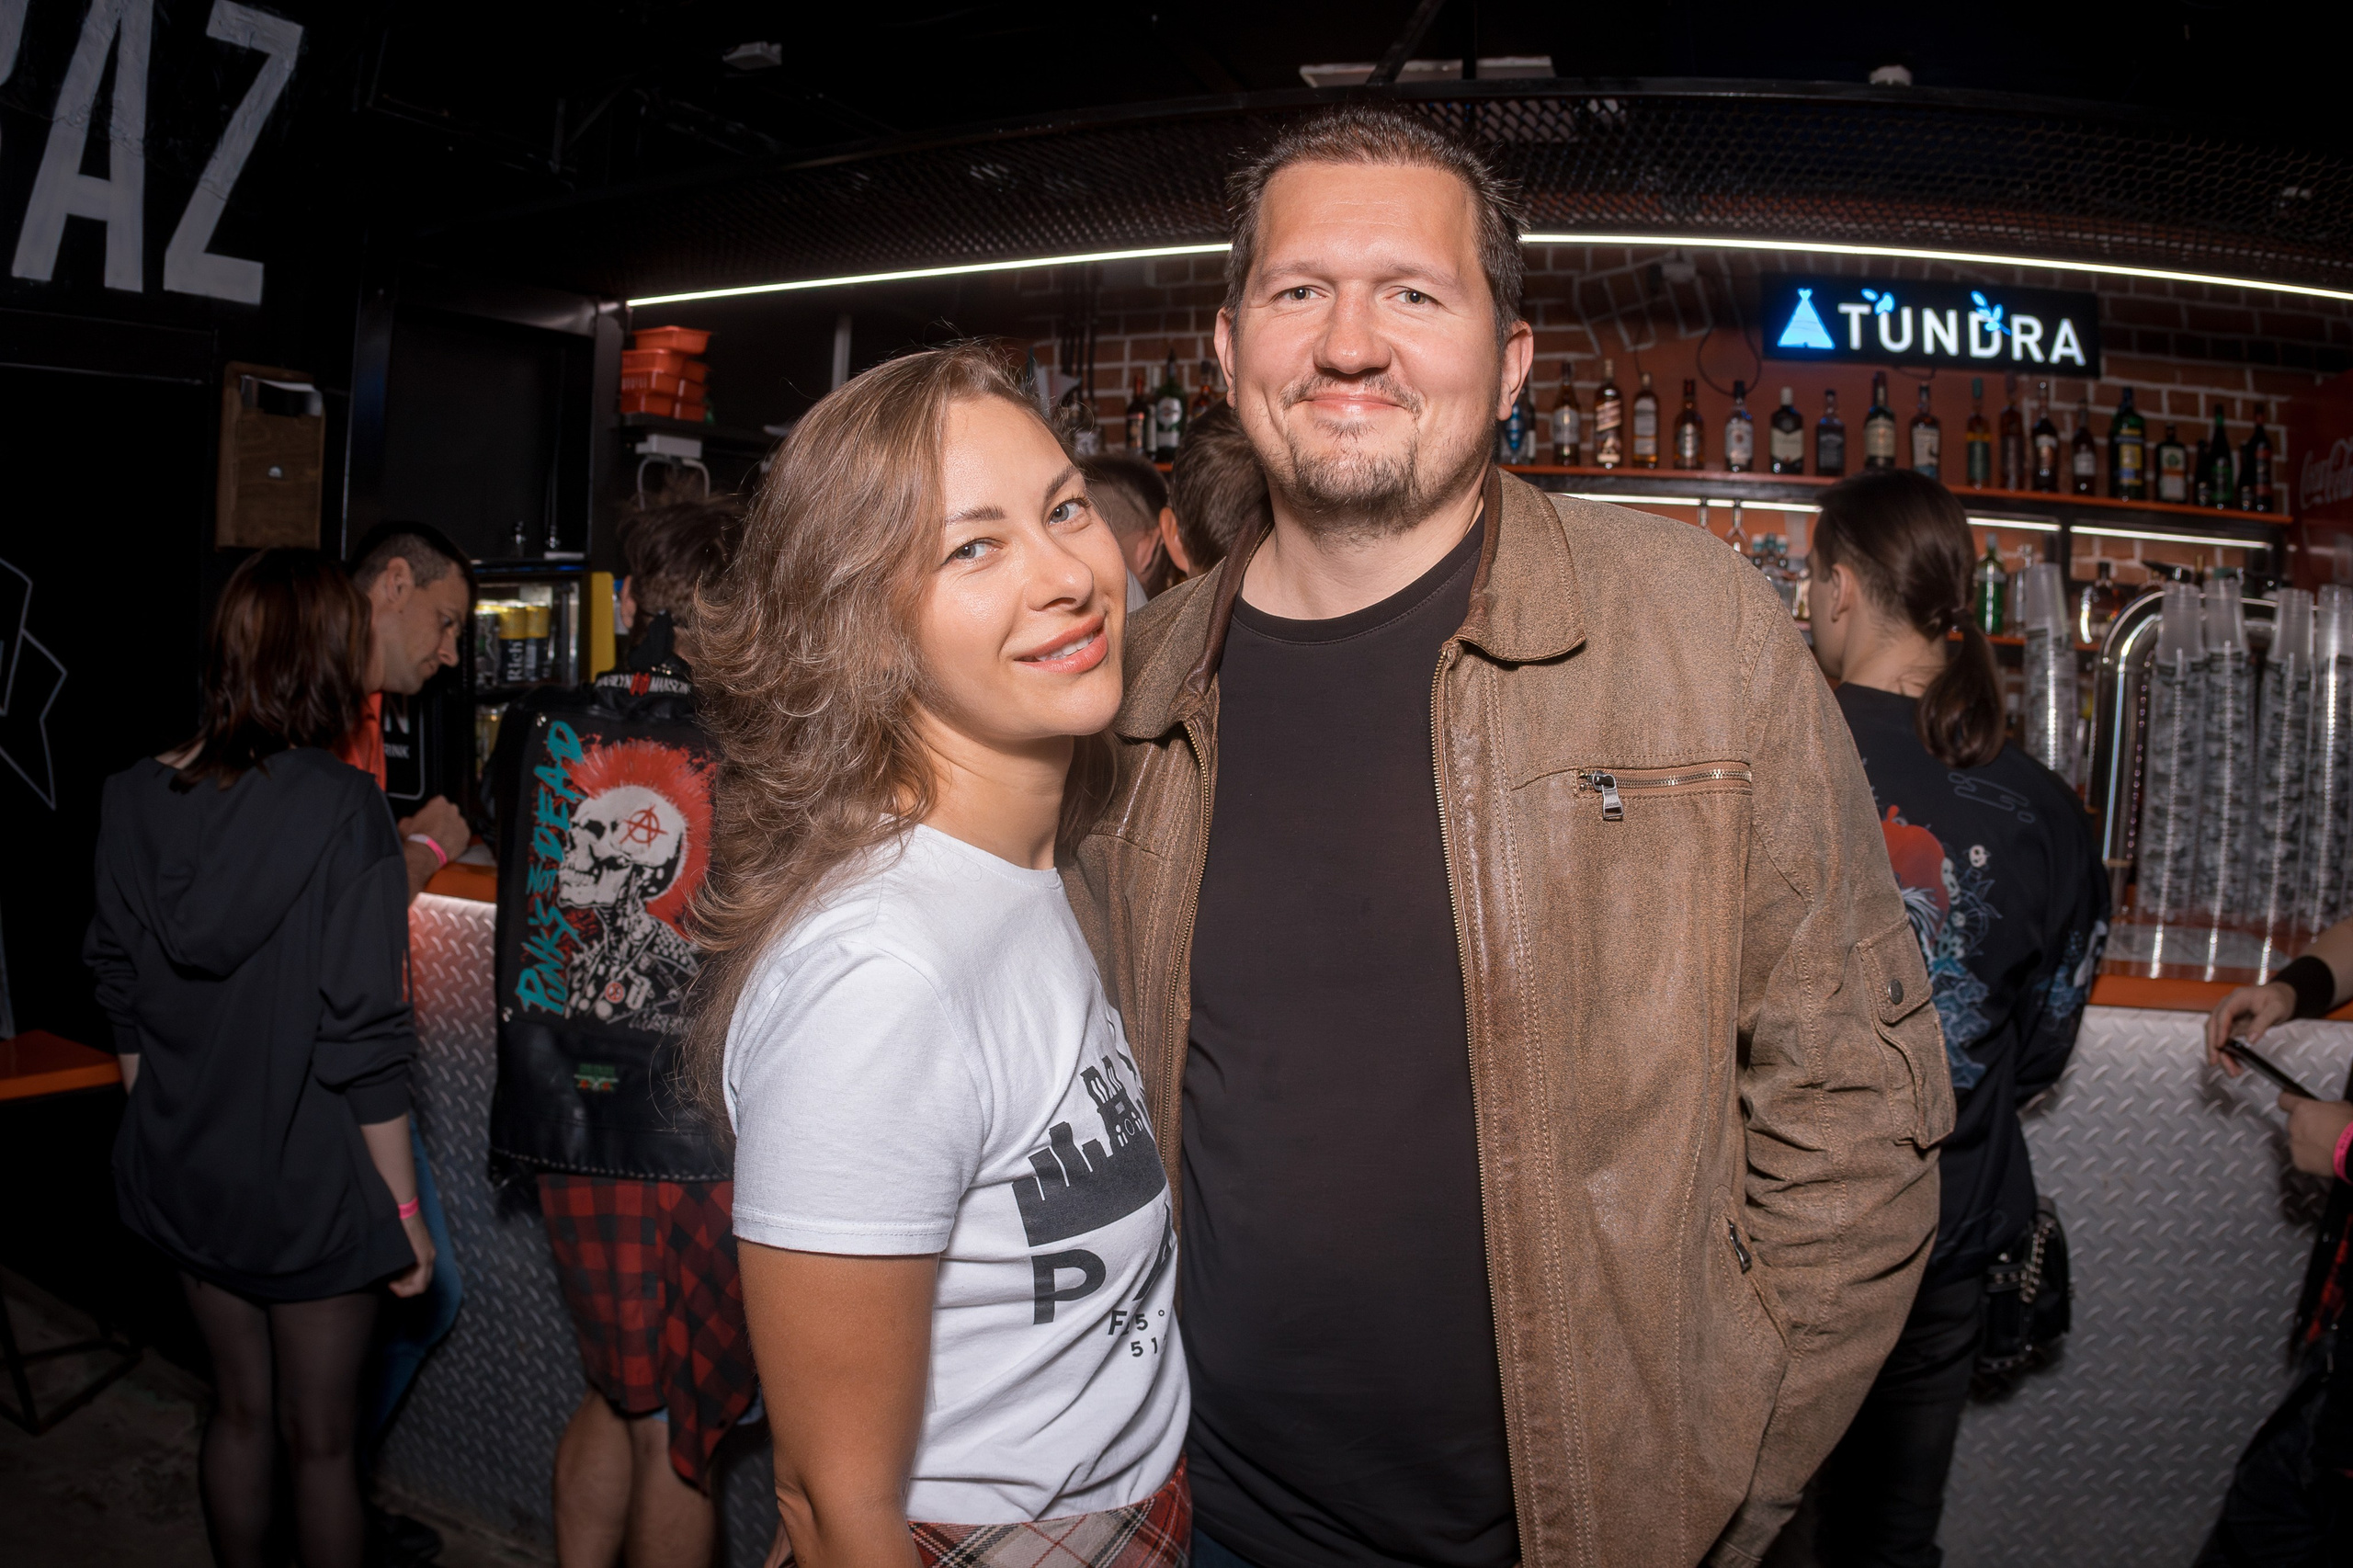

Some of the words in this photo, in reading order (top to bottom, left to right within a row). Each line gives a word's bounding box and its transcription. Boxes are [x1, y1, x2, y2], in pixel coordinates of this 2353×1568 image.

[0, 0, 305, 304] AZ
[1838, 302, 2086, 366] TUNDRA
[506, 641, 524, 681] Rich
[533, 721, 587, 864] DEAD
[525, 861, 558, 903] NOT
[515, 897, 585, 1015] PUNK'S
